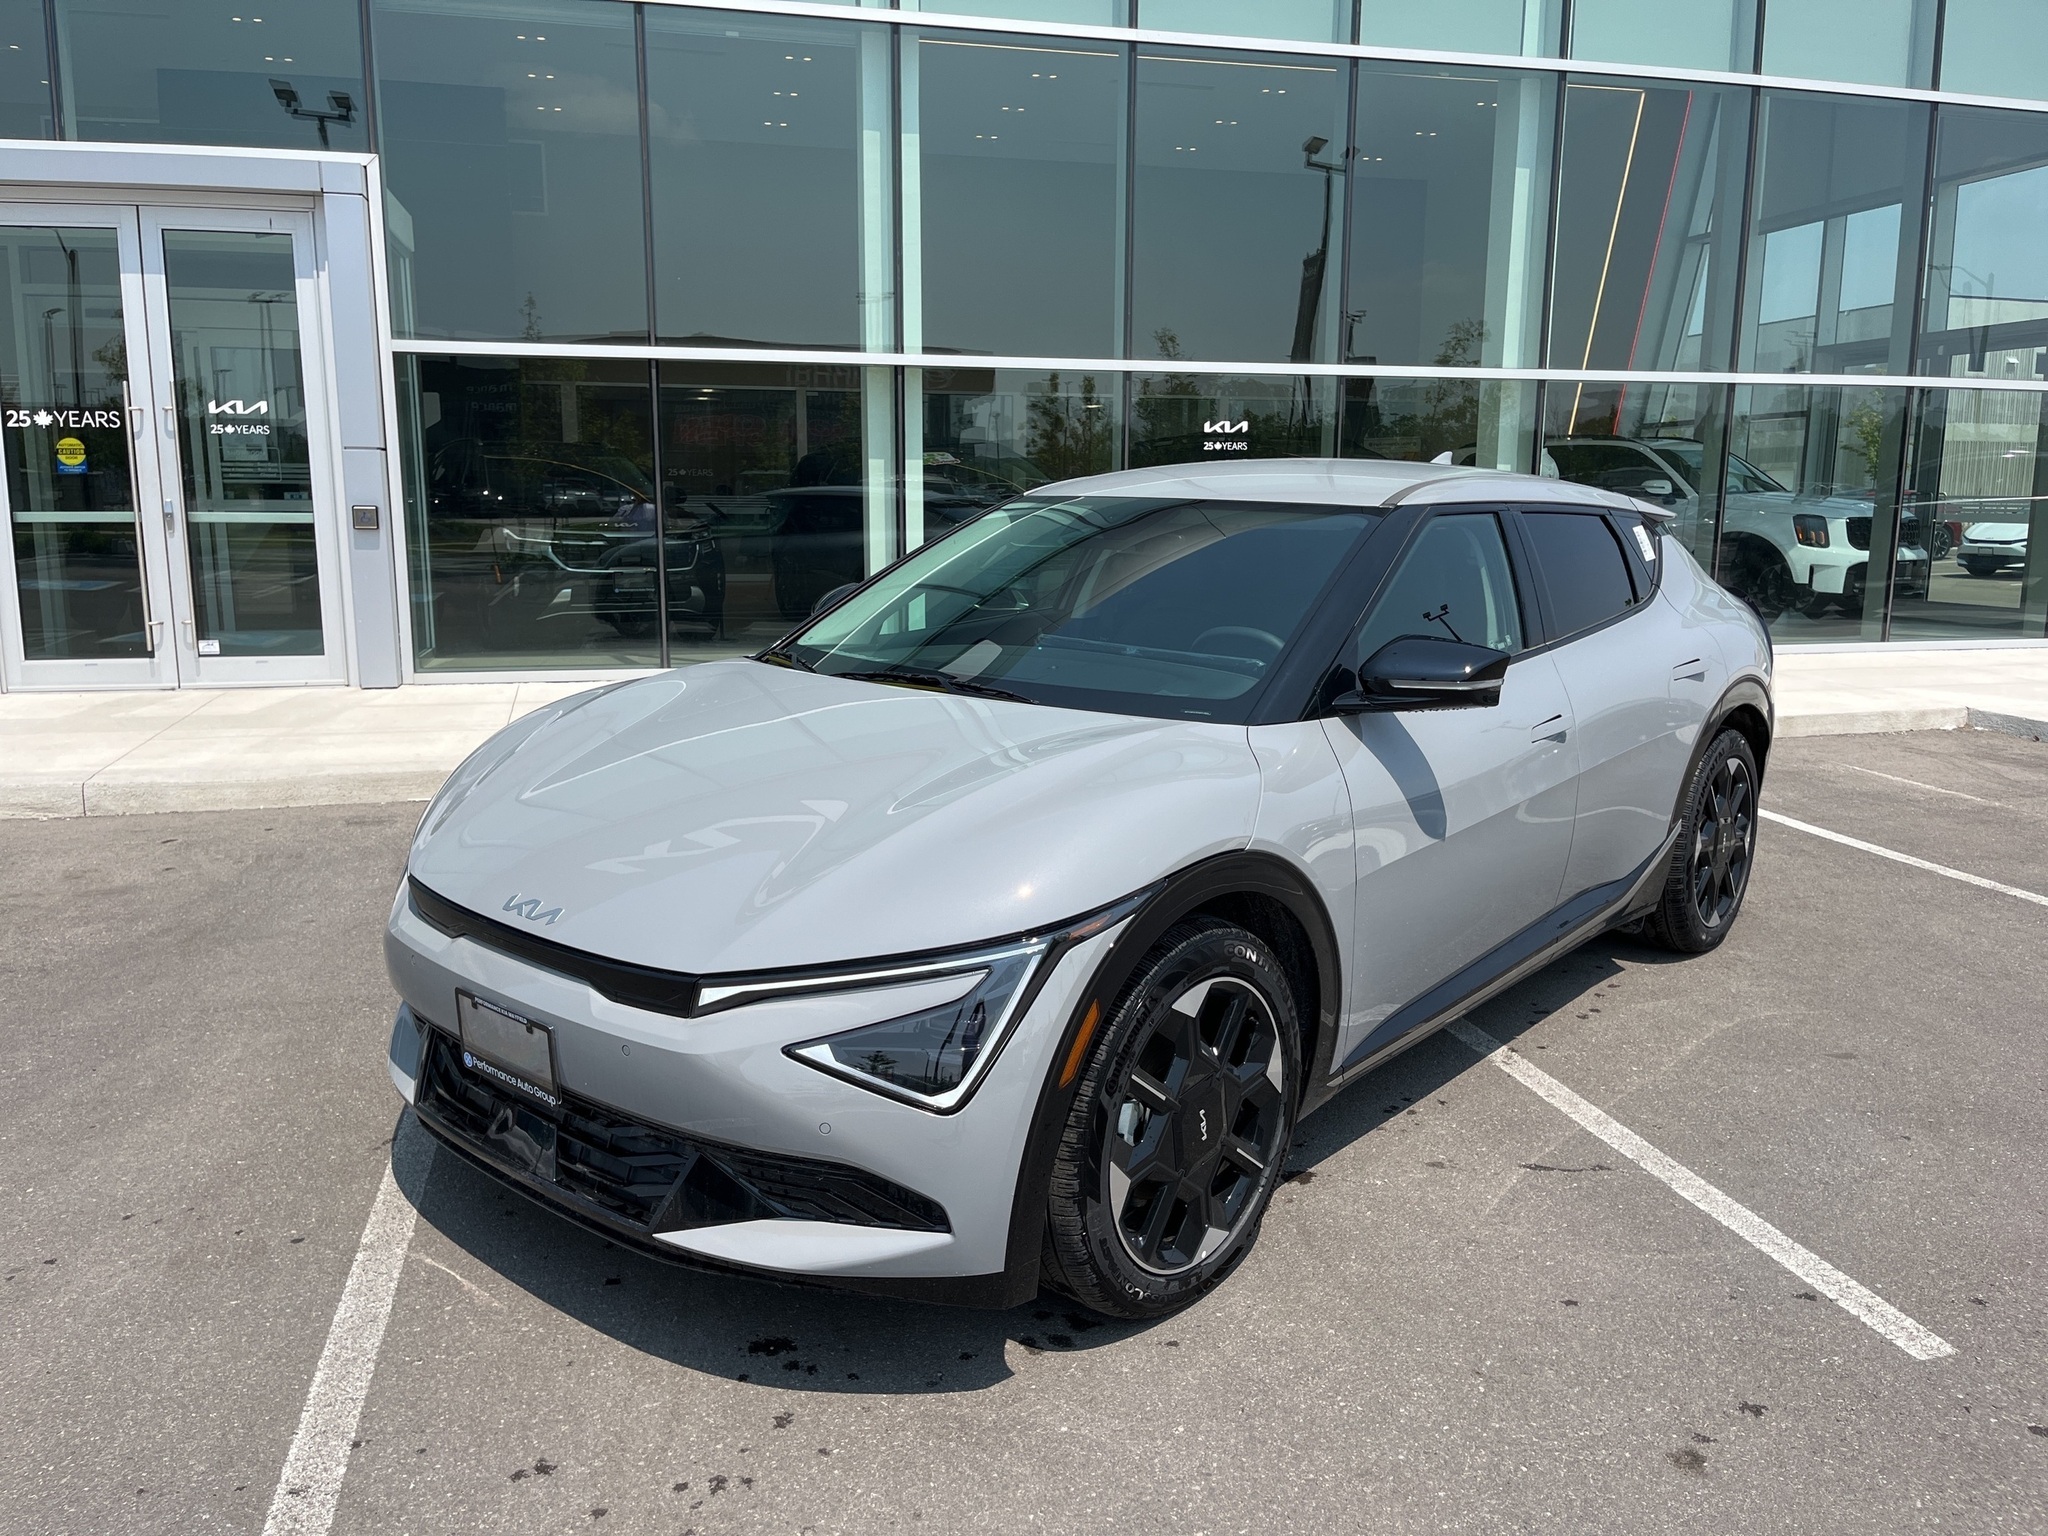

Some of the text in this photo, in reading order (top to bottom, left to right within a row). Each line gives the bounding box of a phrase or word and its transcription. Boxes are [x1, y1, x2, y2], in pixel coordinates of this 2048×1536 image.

[208, 399, 268, 415] KIA
[6, 410, 121, 428] 25 YEARS
[1203, 420, 1249, 433] KIA
[210, 424, 271, 435] 25 YEARS
[1203, 441, 1248, 451] 25 YEARS
[668, 468, 714, 477] 25 YEARS
[502, 892, 565, 926] KIA
[473, 1056, 556, 1107] Performance Auto Group
[1199, 1109, 1207, 1141] KIA
